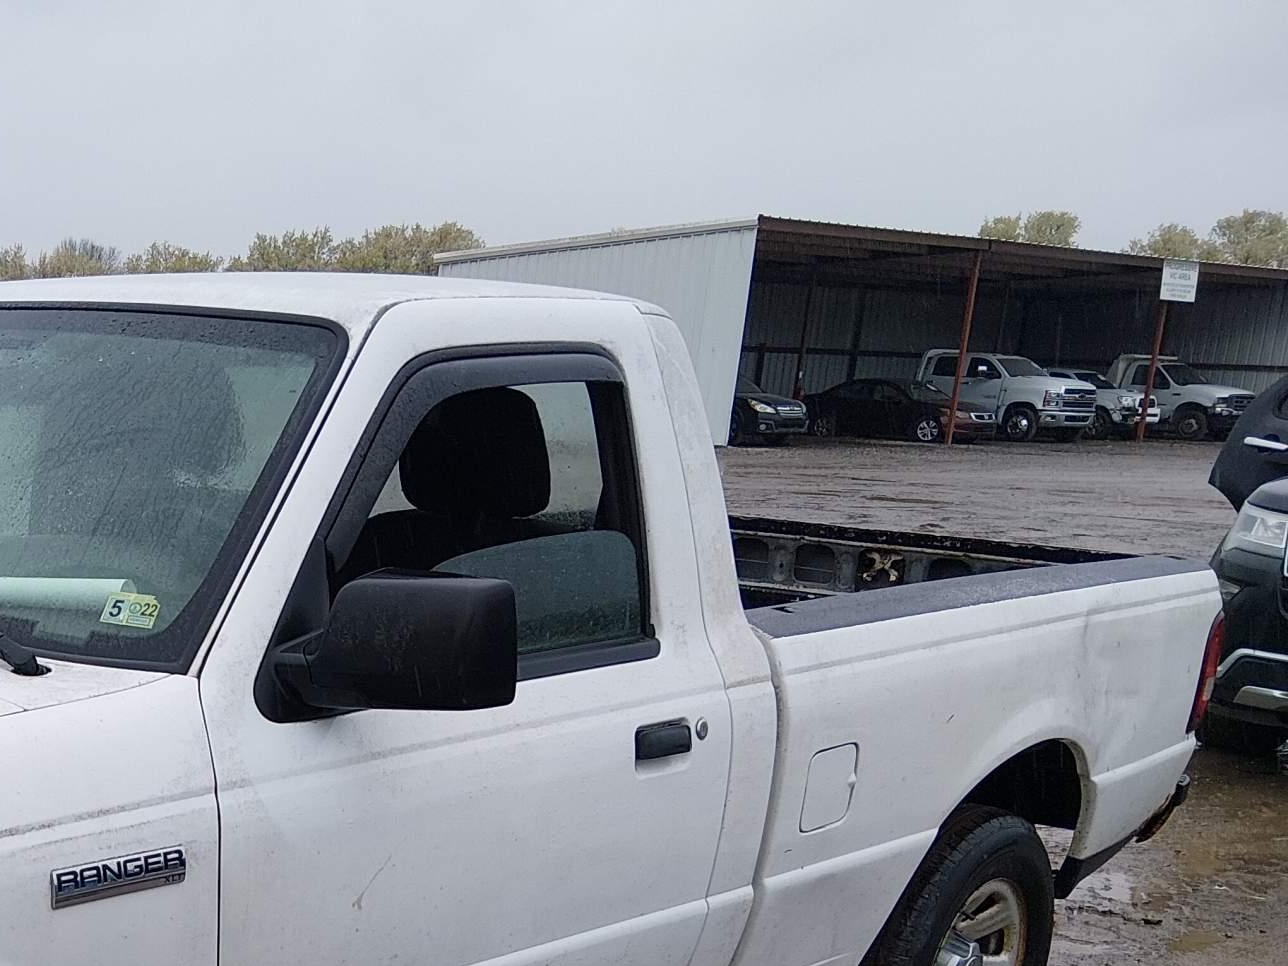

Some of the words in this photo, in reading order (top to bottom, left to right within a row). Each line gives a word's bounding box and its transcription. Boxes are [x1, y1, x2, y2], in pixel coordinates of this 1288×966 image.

[109, 600, 125, 617] 5
[140, 602, 158, 617] 22
[56, 849, 186, 893] RANGER
